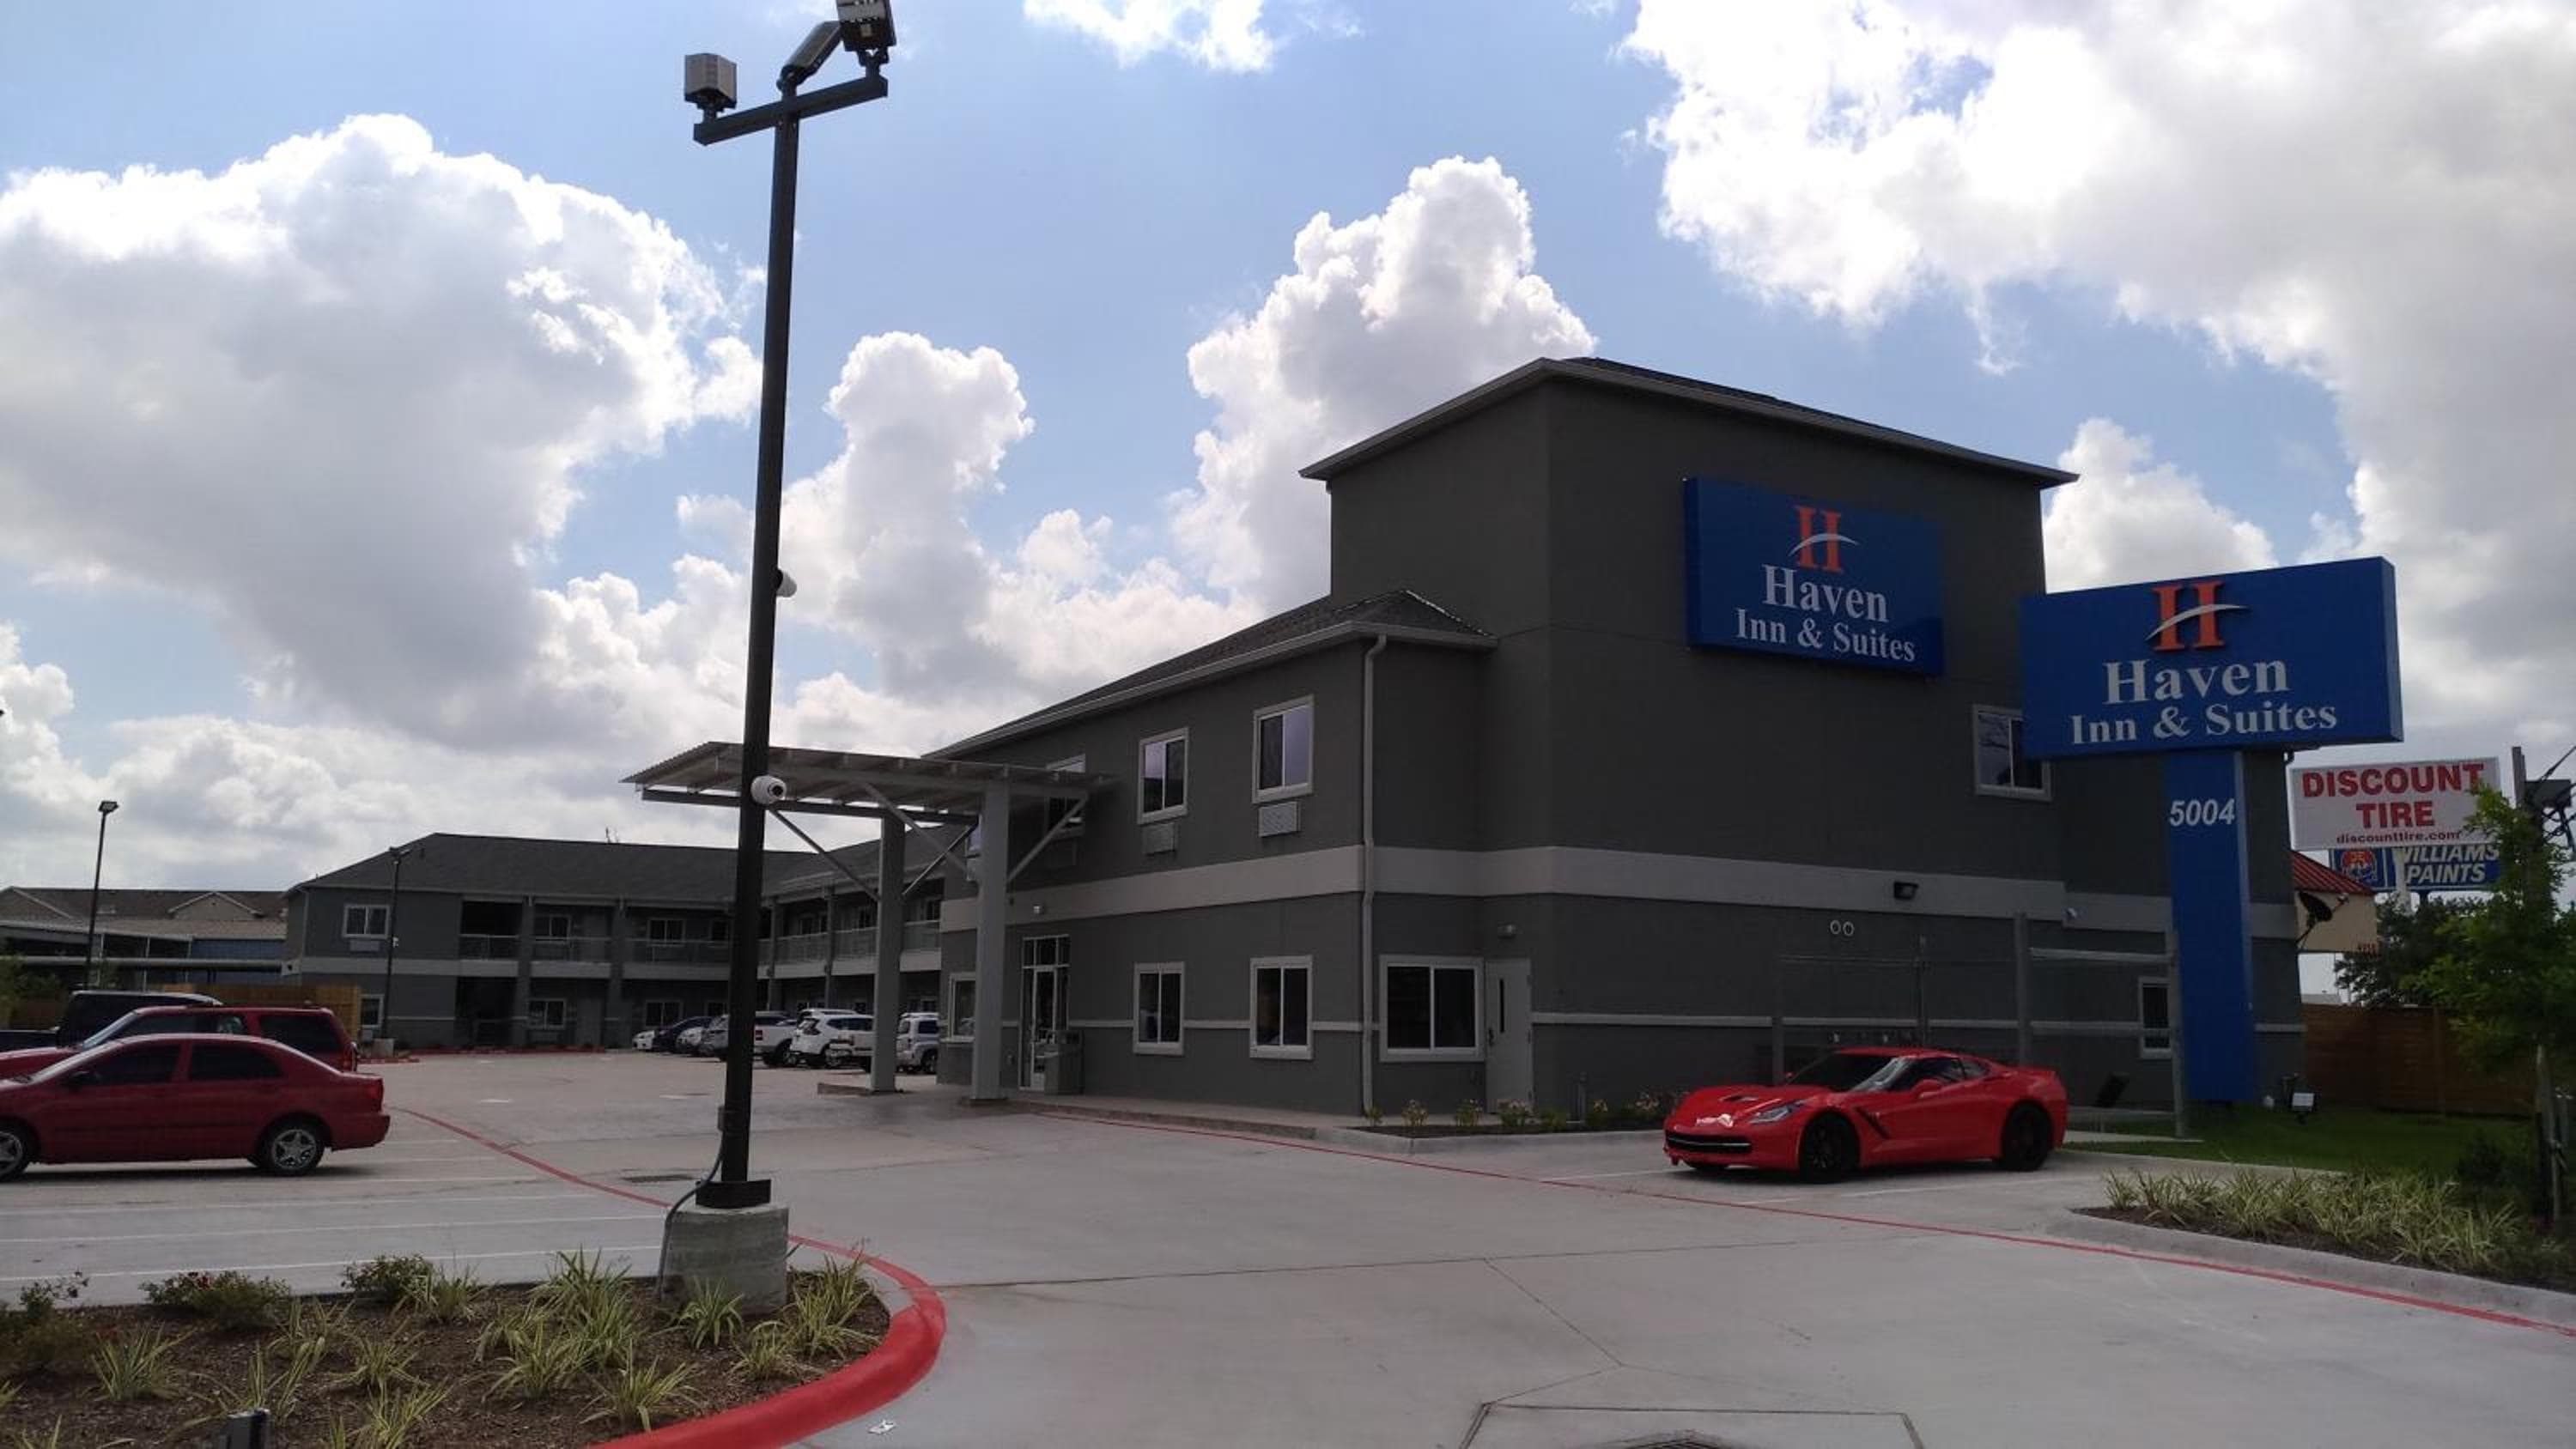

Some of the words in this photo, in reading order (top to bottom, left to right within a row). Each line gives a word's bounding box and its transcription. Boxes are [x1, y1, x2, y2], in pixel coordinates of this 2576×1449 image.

[1795, 505, 1844, 573] H
[1761, 563, 1889, 623] Haven
[1735, 608, 1787, 644] Inn
[1797, 617, 1823, 649] &
[1833, 622, 1916, 662] Suites
[2152, 580, 2225, 652] H
[2102, 658, 2291, 706] Haven
[2069, 714, 2136, 744] Inn
[2154, 706, 2190, 738] &
[2205, 700, 2337, 737] Suites
[2302, 763, 2484, 797] DISCOUNT
[2170, 798, 2235, 827] 5004
[2355, 800, 2435, 828] TIRE
[2336, 831, 2461, 844] discounttire.com
[2405, 863, 2486, 884] PAINTS
